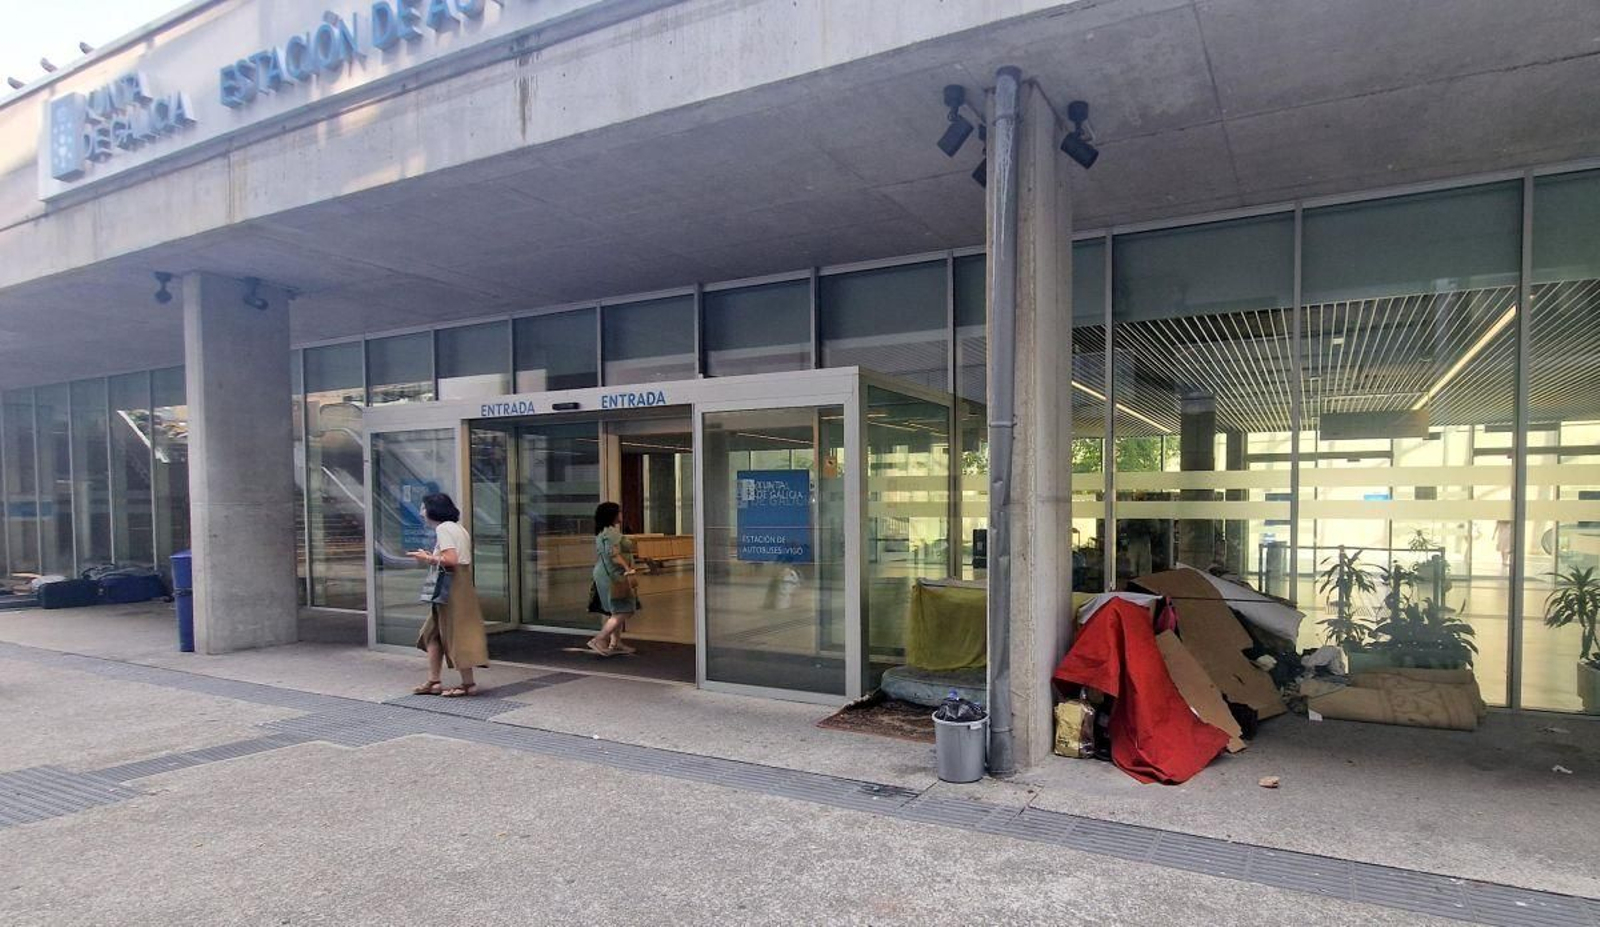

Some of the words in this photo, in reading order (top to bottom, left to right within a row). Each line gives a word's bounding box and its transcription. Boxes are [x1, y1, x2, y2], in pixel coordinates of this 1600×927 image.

[220, 11, 367, 108] ESTACIÓN
[372, 0, 423, 50] DE
[480, 401, 536, 417] ENTRADA
[601, 390, 667, 409] ENTRADA
